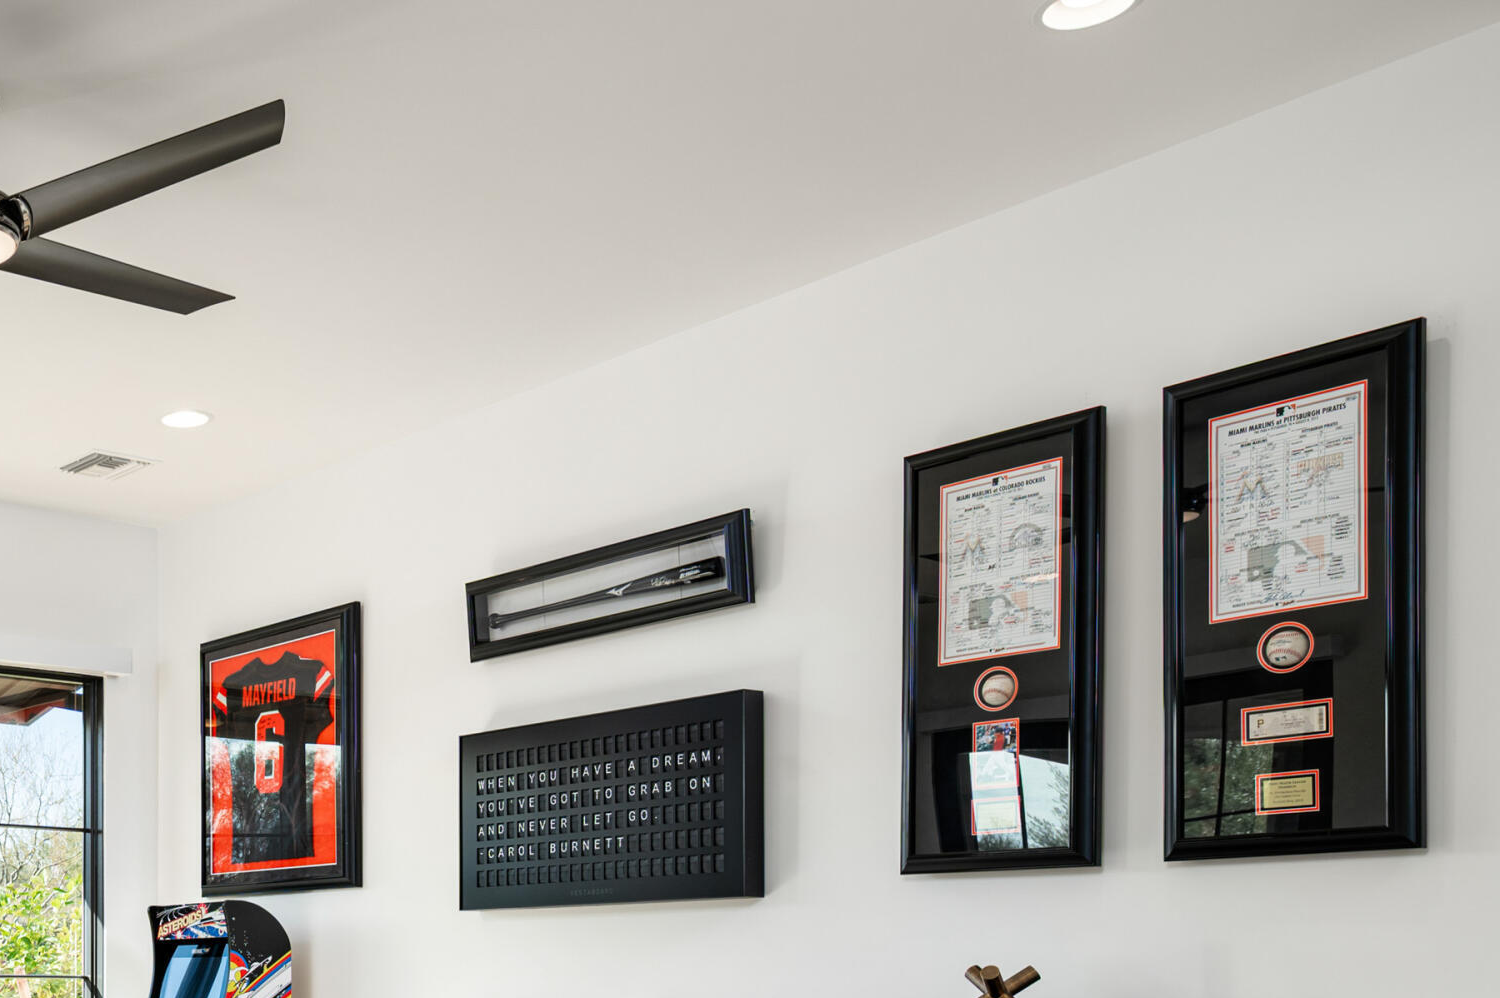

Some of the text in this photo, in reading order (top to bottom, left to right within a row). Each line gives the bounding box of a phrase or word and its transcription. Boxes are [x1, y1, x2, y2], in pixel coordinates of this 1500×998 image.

[1228, 428, 1248, 437] MIAMI
[1249, 421, 1275, 433] MARLINS
[1283, 409, 1321, 424] PITTSBURGH
[1322, 402, 1347, 414] PIRATES
[999, 480, 1025, 492] COLORADO
[242, 677, 296, 708] MAYFIELD
[254, 709, 285, 794] 6
[478, 749, 721, 790] WHEN YOU HAVE A DREAM,
[478, 776, 711, 814] YOU'VE GOT TO GRAB ON
[478, 809, 658, 837] AND NEVER LET GO.
[479, 836, 624, 859] -CAROL BURNETT
[156, 909, 203, 940] ASTEROIDS
